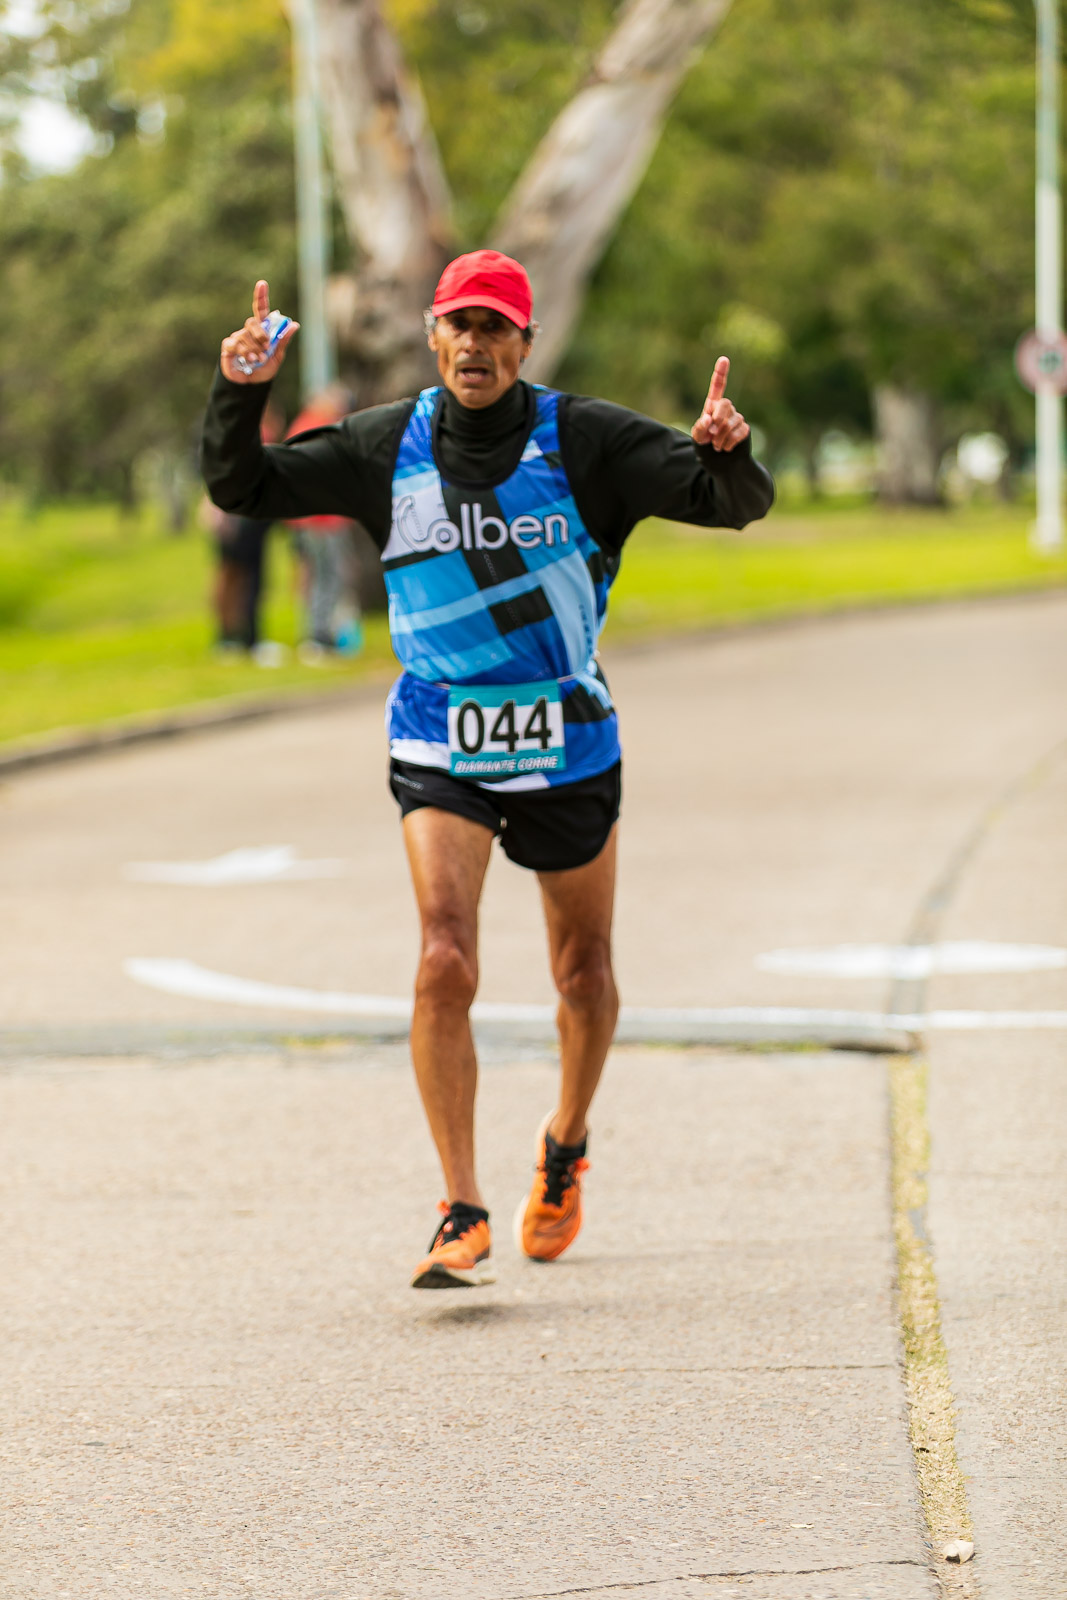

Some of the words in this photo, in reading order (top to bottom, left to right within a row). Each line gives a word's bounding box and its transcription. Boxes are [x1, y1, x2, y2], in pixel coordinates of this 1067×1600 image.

[456, 696, 552, 755] 044
[454, 760, 516, 773] DIAMANTE
[517, 756, 558, 771] CORRE
